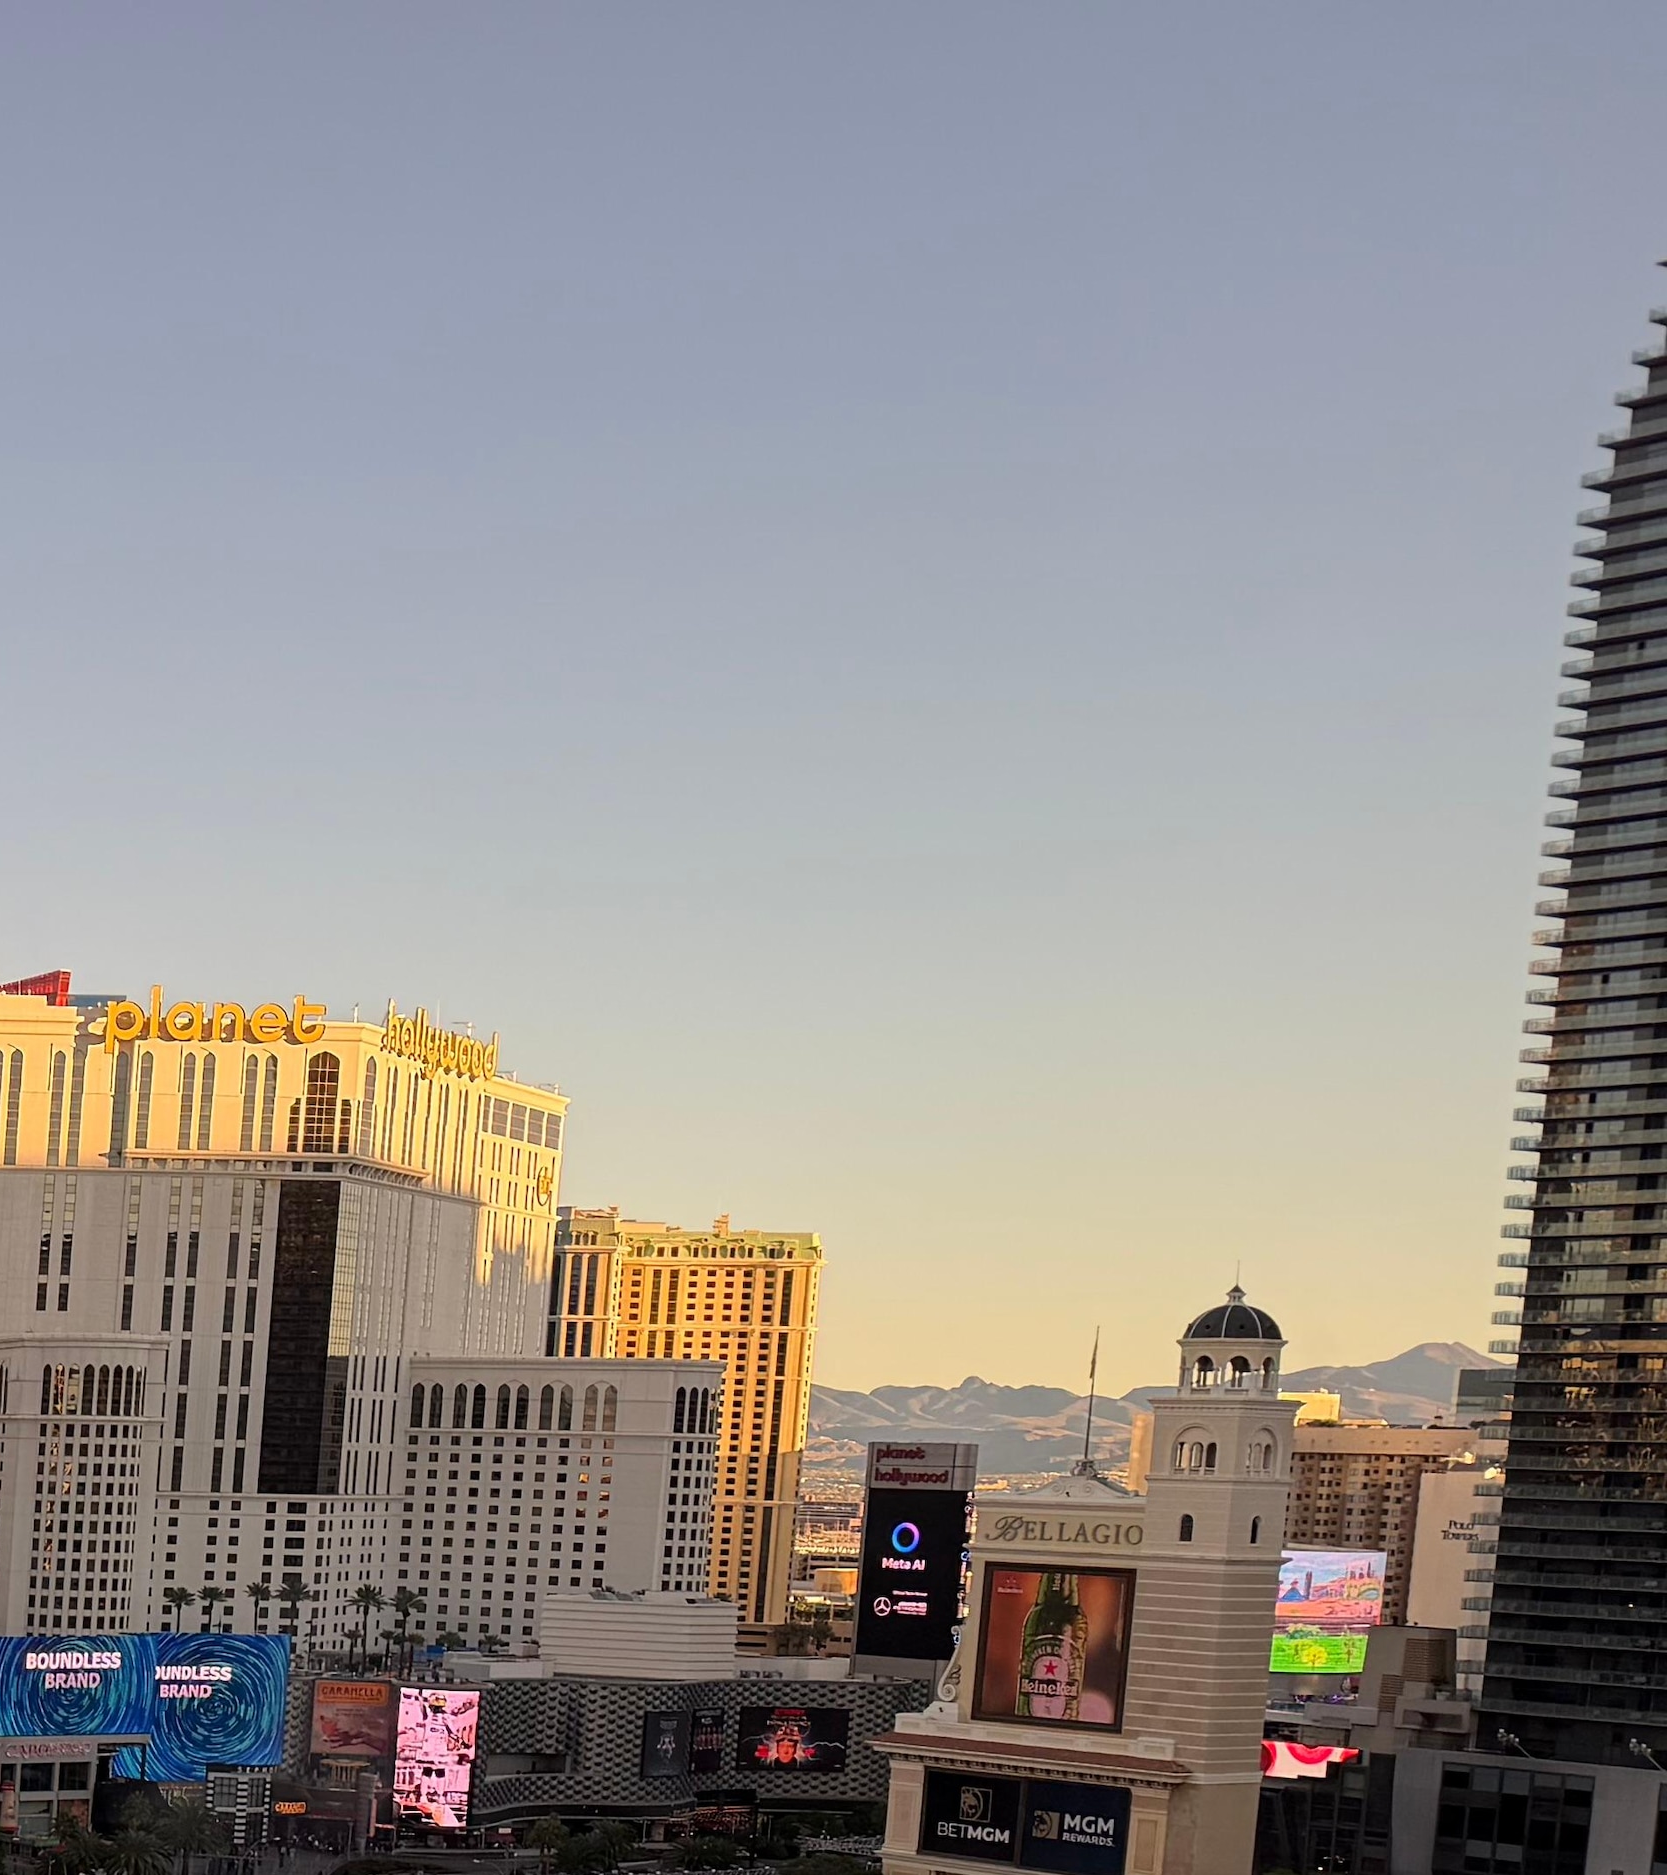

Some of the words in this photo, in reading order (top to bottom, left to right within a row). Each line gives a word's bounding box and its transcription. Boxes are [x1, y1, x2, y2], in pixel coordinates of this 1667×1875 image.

[104, 984, 327, 1053] planet
[380, 998, 499, 1081] hollywood
[875, 1444, 926, 1463] planet
[874, 1466, 949, 1486] hollywood
[985, 1515, 1144, 1546] BELLAGIO
[1448, 1519, 1475, 1531] POLO
[881, 1556, 911, 1570] Meta
[912, 1558, 926, 1571] AI
[25, 1651, 123, 1670] BOUNDLESS
[44, 1671, 101, 1690] BRAND
[1020, 1678, 1079, 1697] Heineken
[159, 1684, 213, 1699] BRAND
[321, 1686, 383, 1698] CARAMELLA
[936, 1821, 1011, 1844] BETMGM
[1063, 1813, 1115, 1836] MGM
